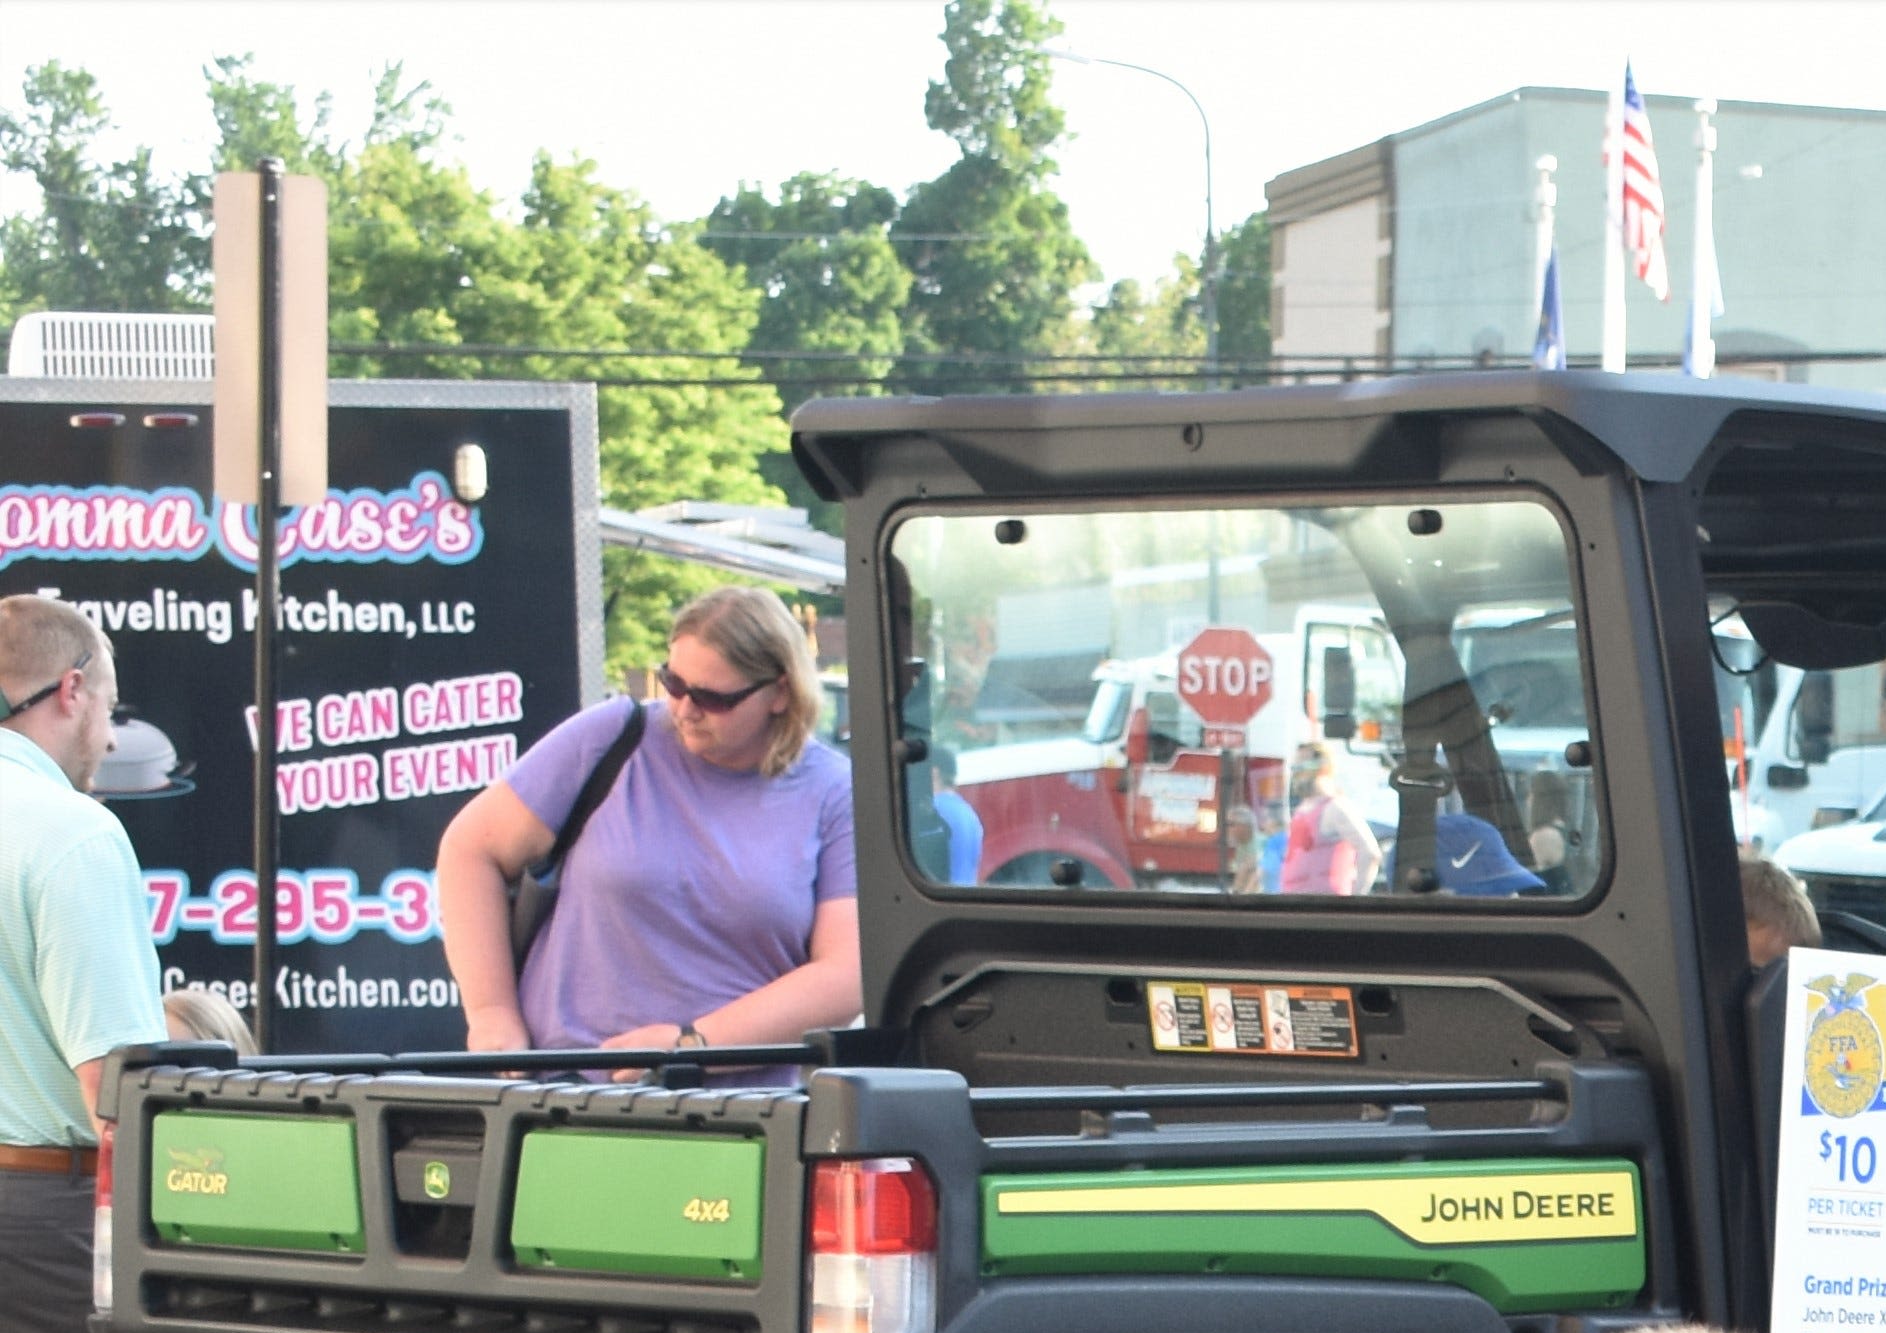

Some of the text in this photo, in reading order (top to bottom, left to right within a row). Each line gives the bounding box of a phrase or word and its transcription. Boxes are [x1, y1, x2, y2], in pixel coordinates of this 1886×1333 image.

[0, 497, 203, 552] omma
[422, 600, 475, 634] LLC
[1181, 655, 1272, 697] STOP
[317, 687, 398, 747] CAN
[404, 672, 522, 735] CATER
[277, 754, 379, 815] YOUR
[1829, 1036, 1858, 1052] FFA
[1820, 1130, 1877, 1184] $10
[166, 1168, 227, 1196] GATOR
[1420, 1189, 1616, 1224] JOHN DEERE
[1808, 1198, 1884, 1218] PER TICKET
[1804, 1275, 1853, 1296] Grand
[1803, 1307, 1834, 1322] John
[1839, 1307, 1875, 1325] Deere
